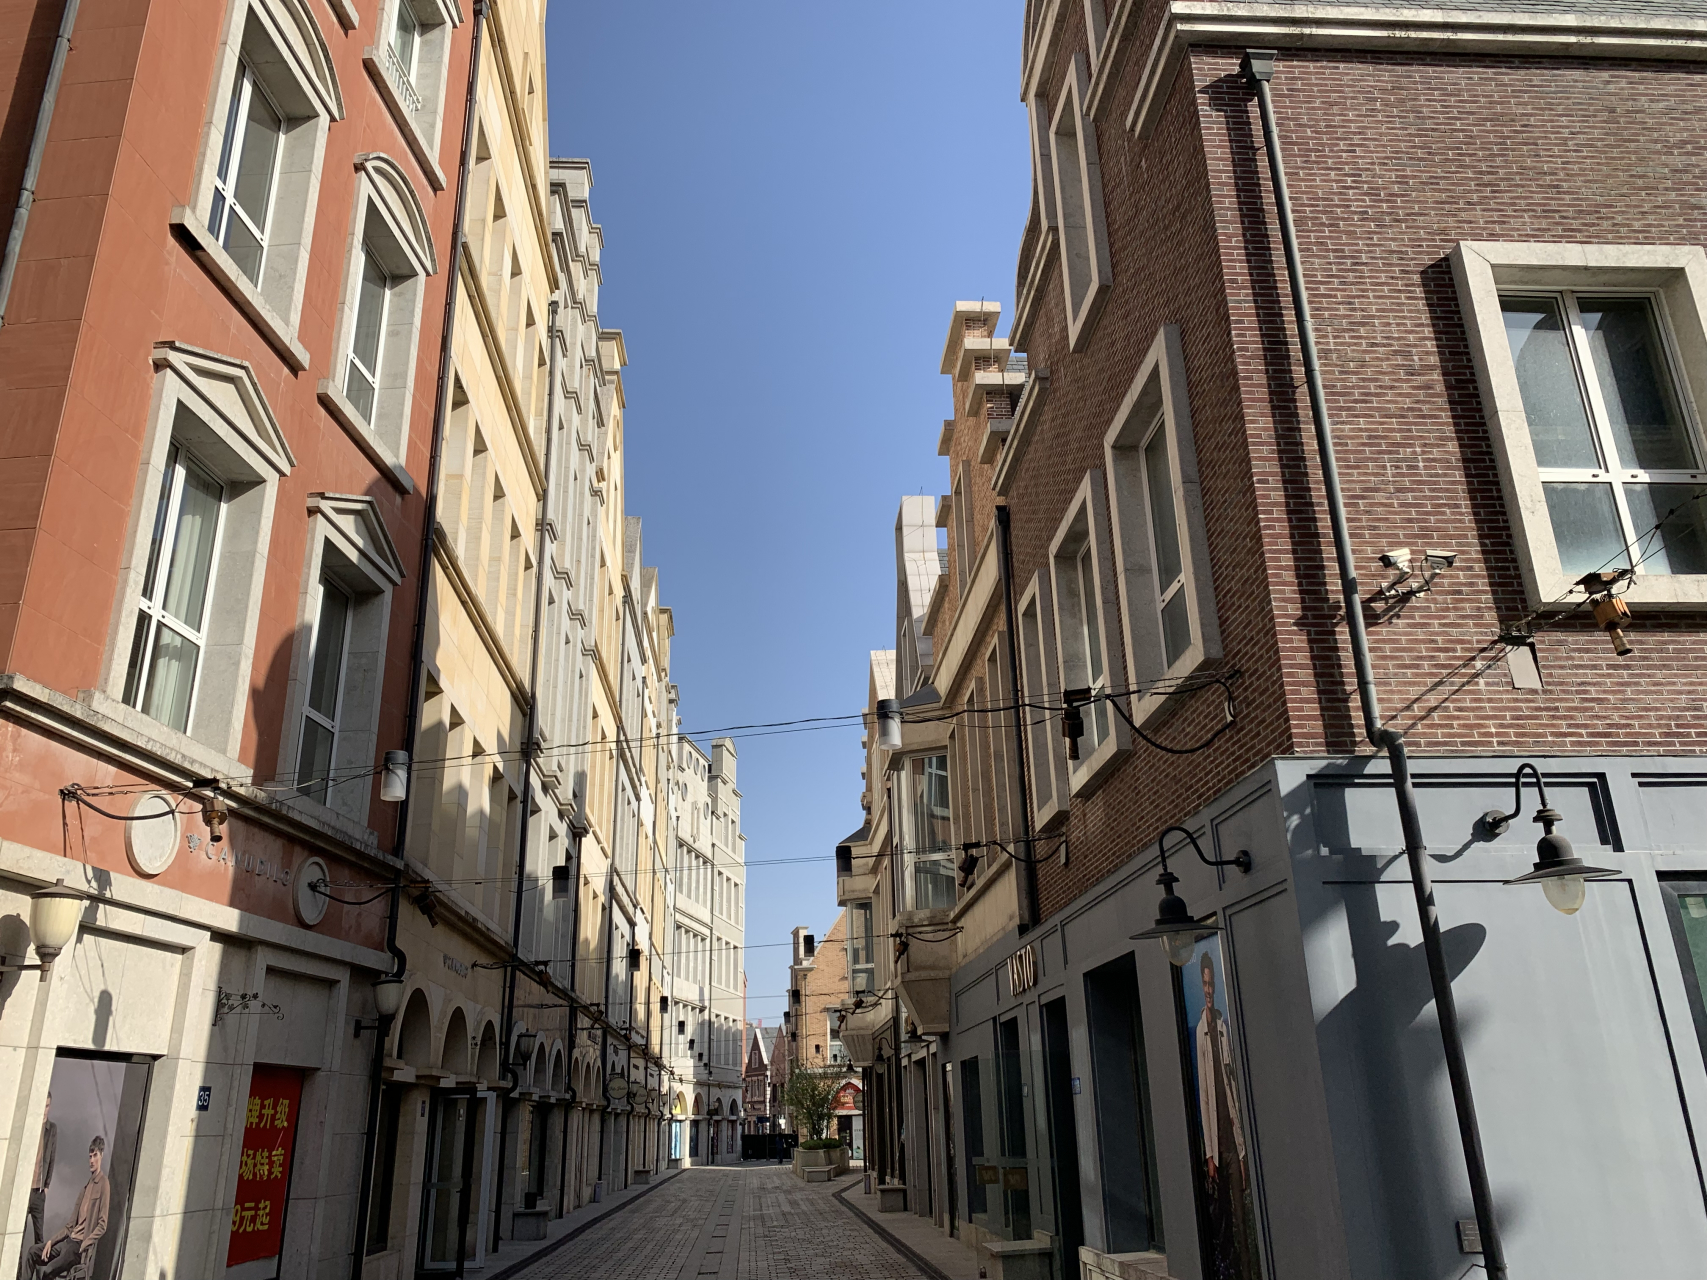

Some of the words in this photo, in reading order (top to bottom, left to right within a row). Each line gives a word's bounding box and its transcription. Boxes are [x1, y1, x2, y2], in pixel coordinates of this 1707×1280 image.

[204, 840, 293, 887] CANUDILO
[1007, 944, 1036, 997] VASTO
[198, 1091, 210, 1106] 35
[244, 1096, 290, 1129] 牌升级
[239, 1146, 285, 1181] 场特卖
[231, 1199, 271, 1234] 9元起
